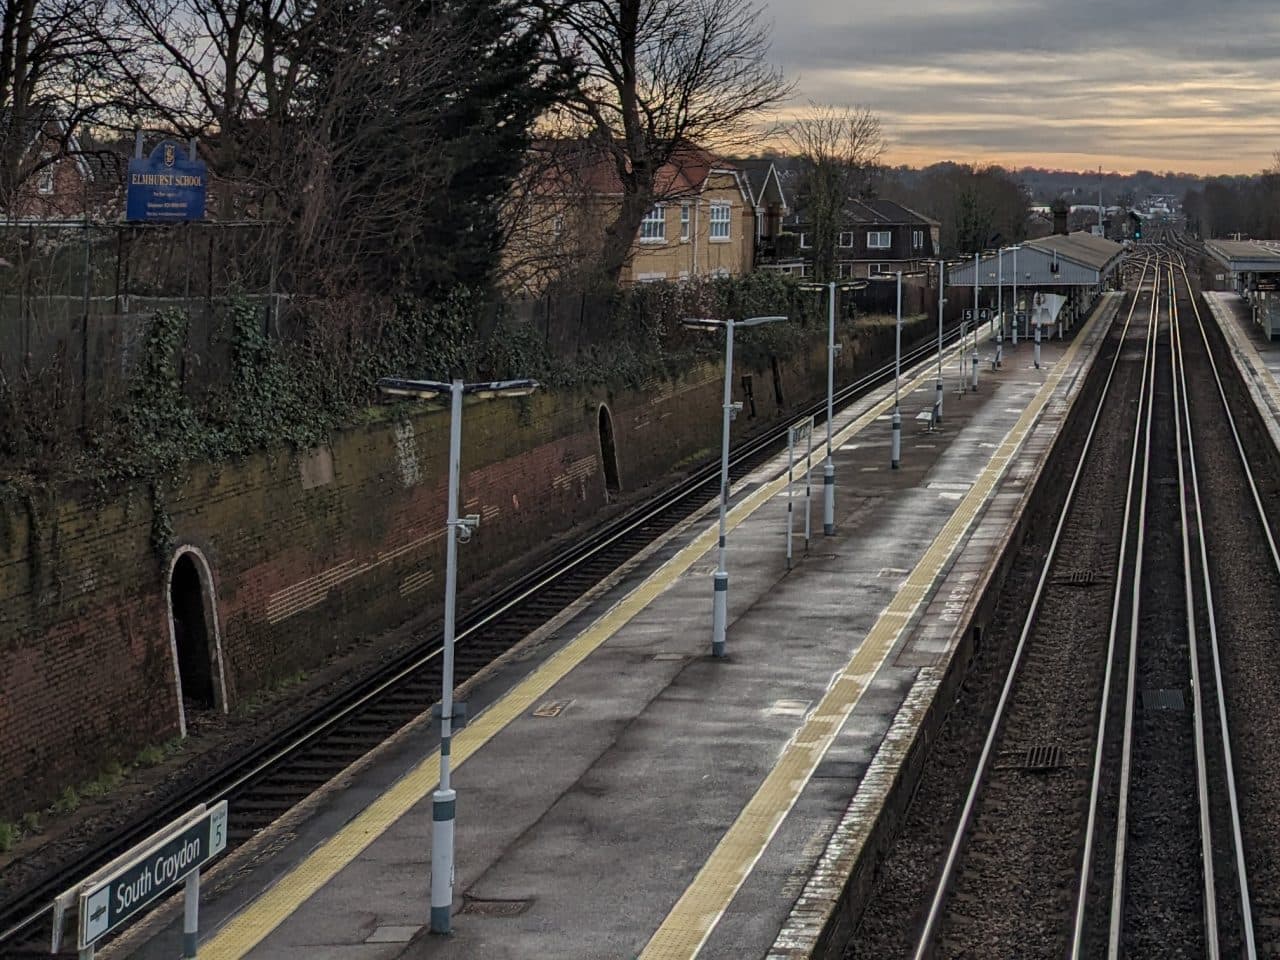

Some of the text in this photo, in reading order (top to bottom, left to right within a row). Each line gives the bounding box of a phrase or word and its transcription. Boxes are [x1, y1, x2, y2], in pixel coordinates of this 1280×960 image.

[132, 173, 203, 187] ELMHURST SCHOOL
[215, 823, 222, 847] 5
[115, 837, 200, 914] South Croydon
